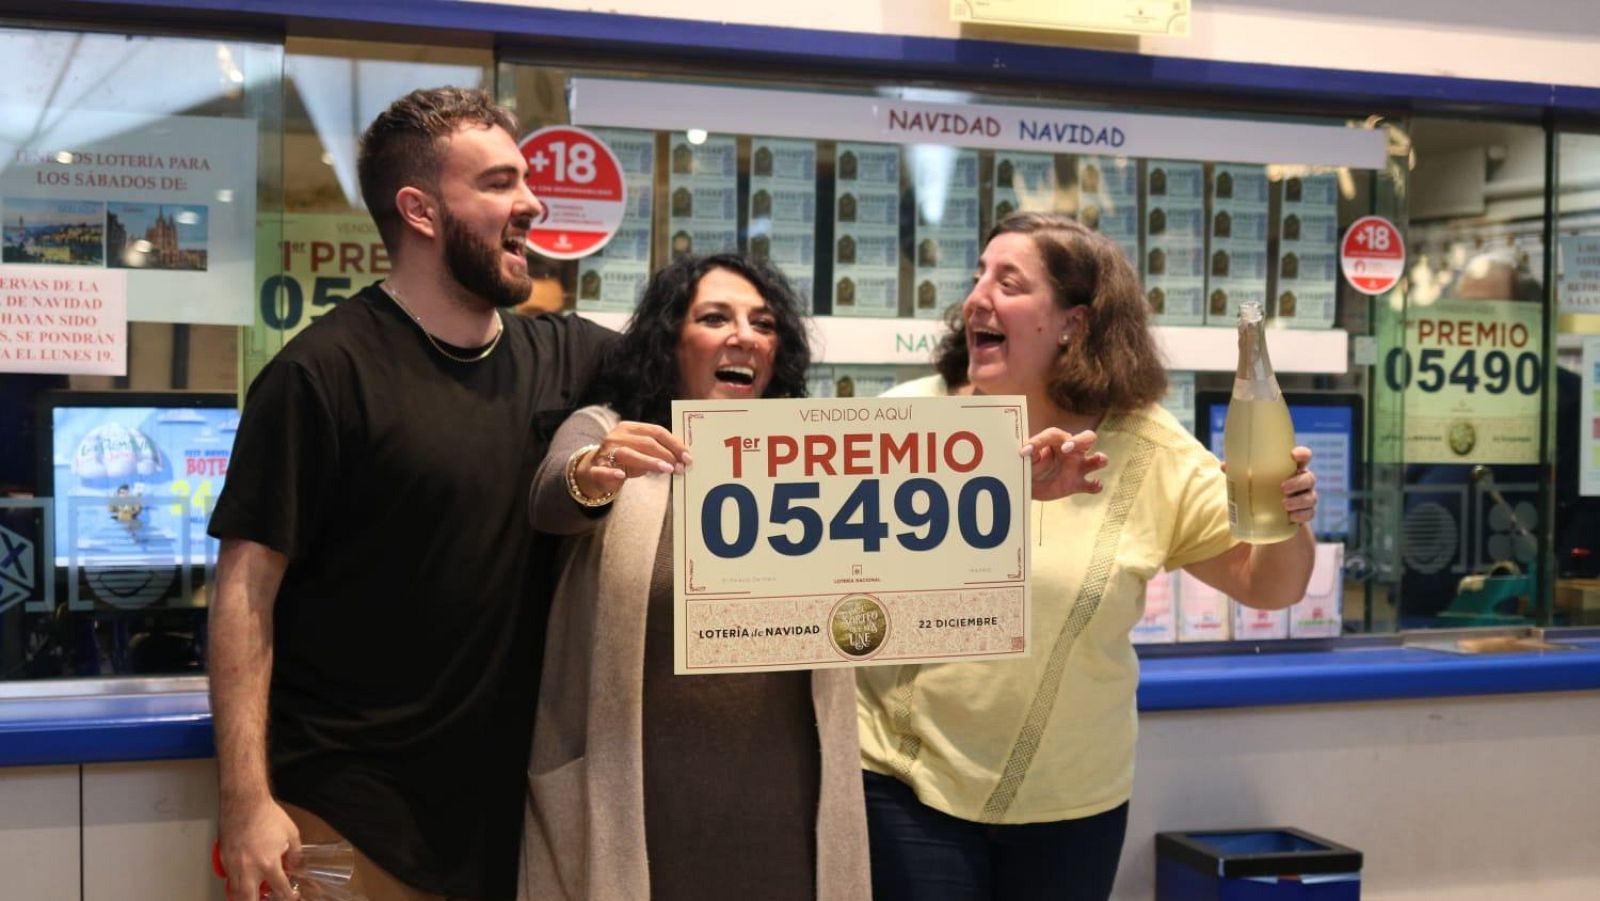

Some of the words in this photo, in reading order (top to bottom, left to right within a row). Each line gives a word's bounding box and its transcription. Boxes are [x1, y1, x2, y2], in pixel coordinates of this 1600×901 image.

[889, 109, 1001, 138] NAVIDAD
[1019, 120, 1125, 148] NAVIDAD
[97, 152, 163, 169] LOTERÍA
[169, 157, 210, 171] PARA
[529, 141, 597, 184] +18
[37, 171, 70, 185] LOS
[75, 170, 156, 189] SÁBADOS
[161, 177, 187, 190] DE:
[1354, 224, 1390, 251] +18
[54, 280, 72, 291] DE
[79, 281, 99, 292] LA
[6, 296, 25, 307] DE
[32, 296, 102, 310] NAVIDAD
[1, 313, 54, 325] HAYAN
[59, 315, 97, 327] SIDO
[16, 331, 32, 343] SE
[1418, 320, 1528, 348] PREMIO
[16, 348, 36, 360] EL
[41, 349, 92, 361] LUNES
[97, 350, 113, 362] 19.
[1385, 347, 1542, 396] 05490
[799, 408, 869, 423] VENDIDO
[875, 404, 912, 421] AQUÍ
[723, 436, 761, 478] 1er
[768, 431, 984, 477] PREMIO
[187, 457, 227, 477] BOTE
[701, 476, 1011, 559] 05490
[699, 626, 749, 639] LOTERÍA
[766, 624, 820, 636] NAVIDAD
[918, 620, 932, 629] 22
[936, 616, 998, 628] DICIEMBRE
